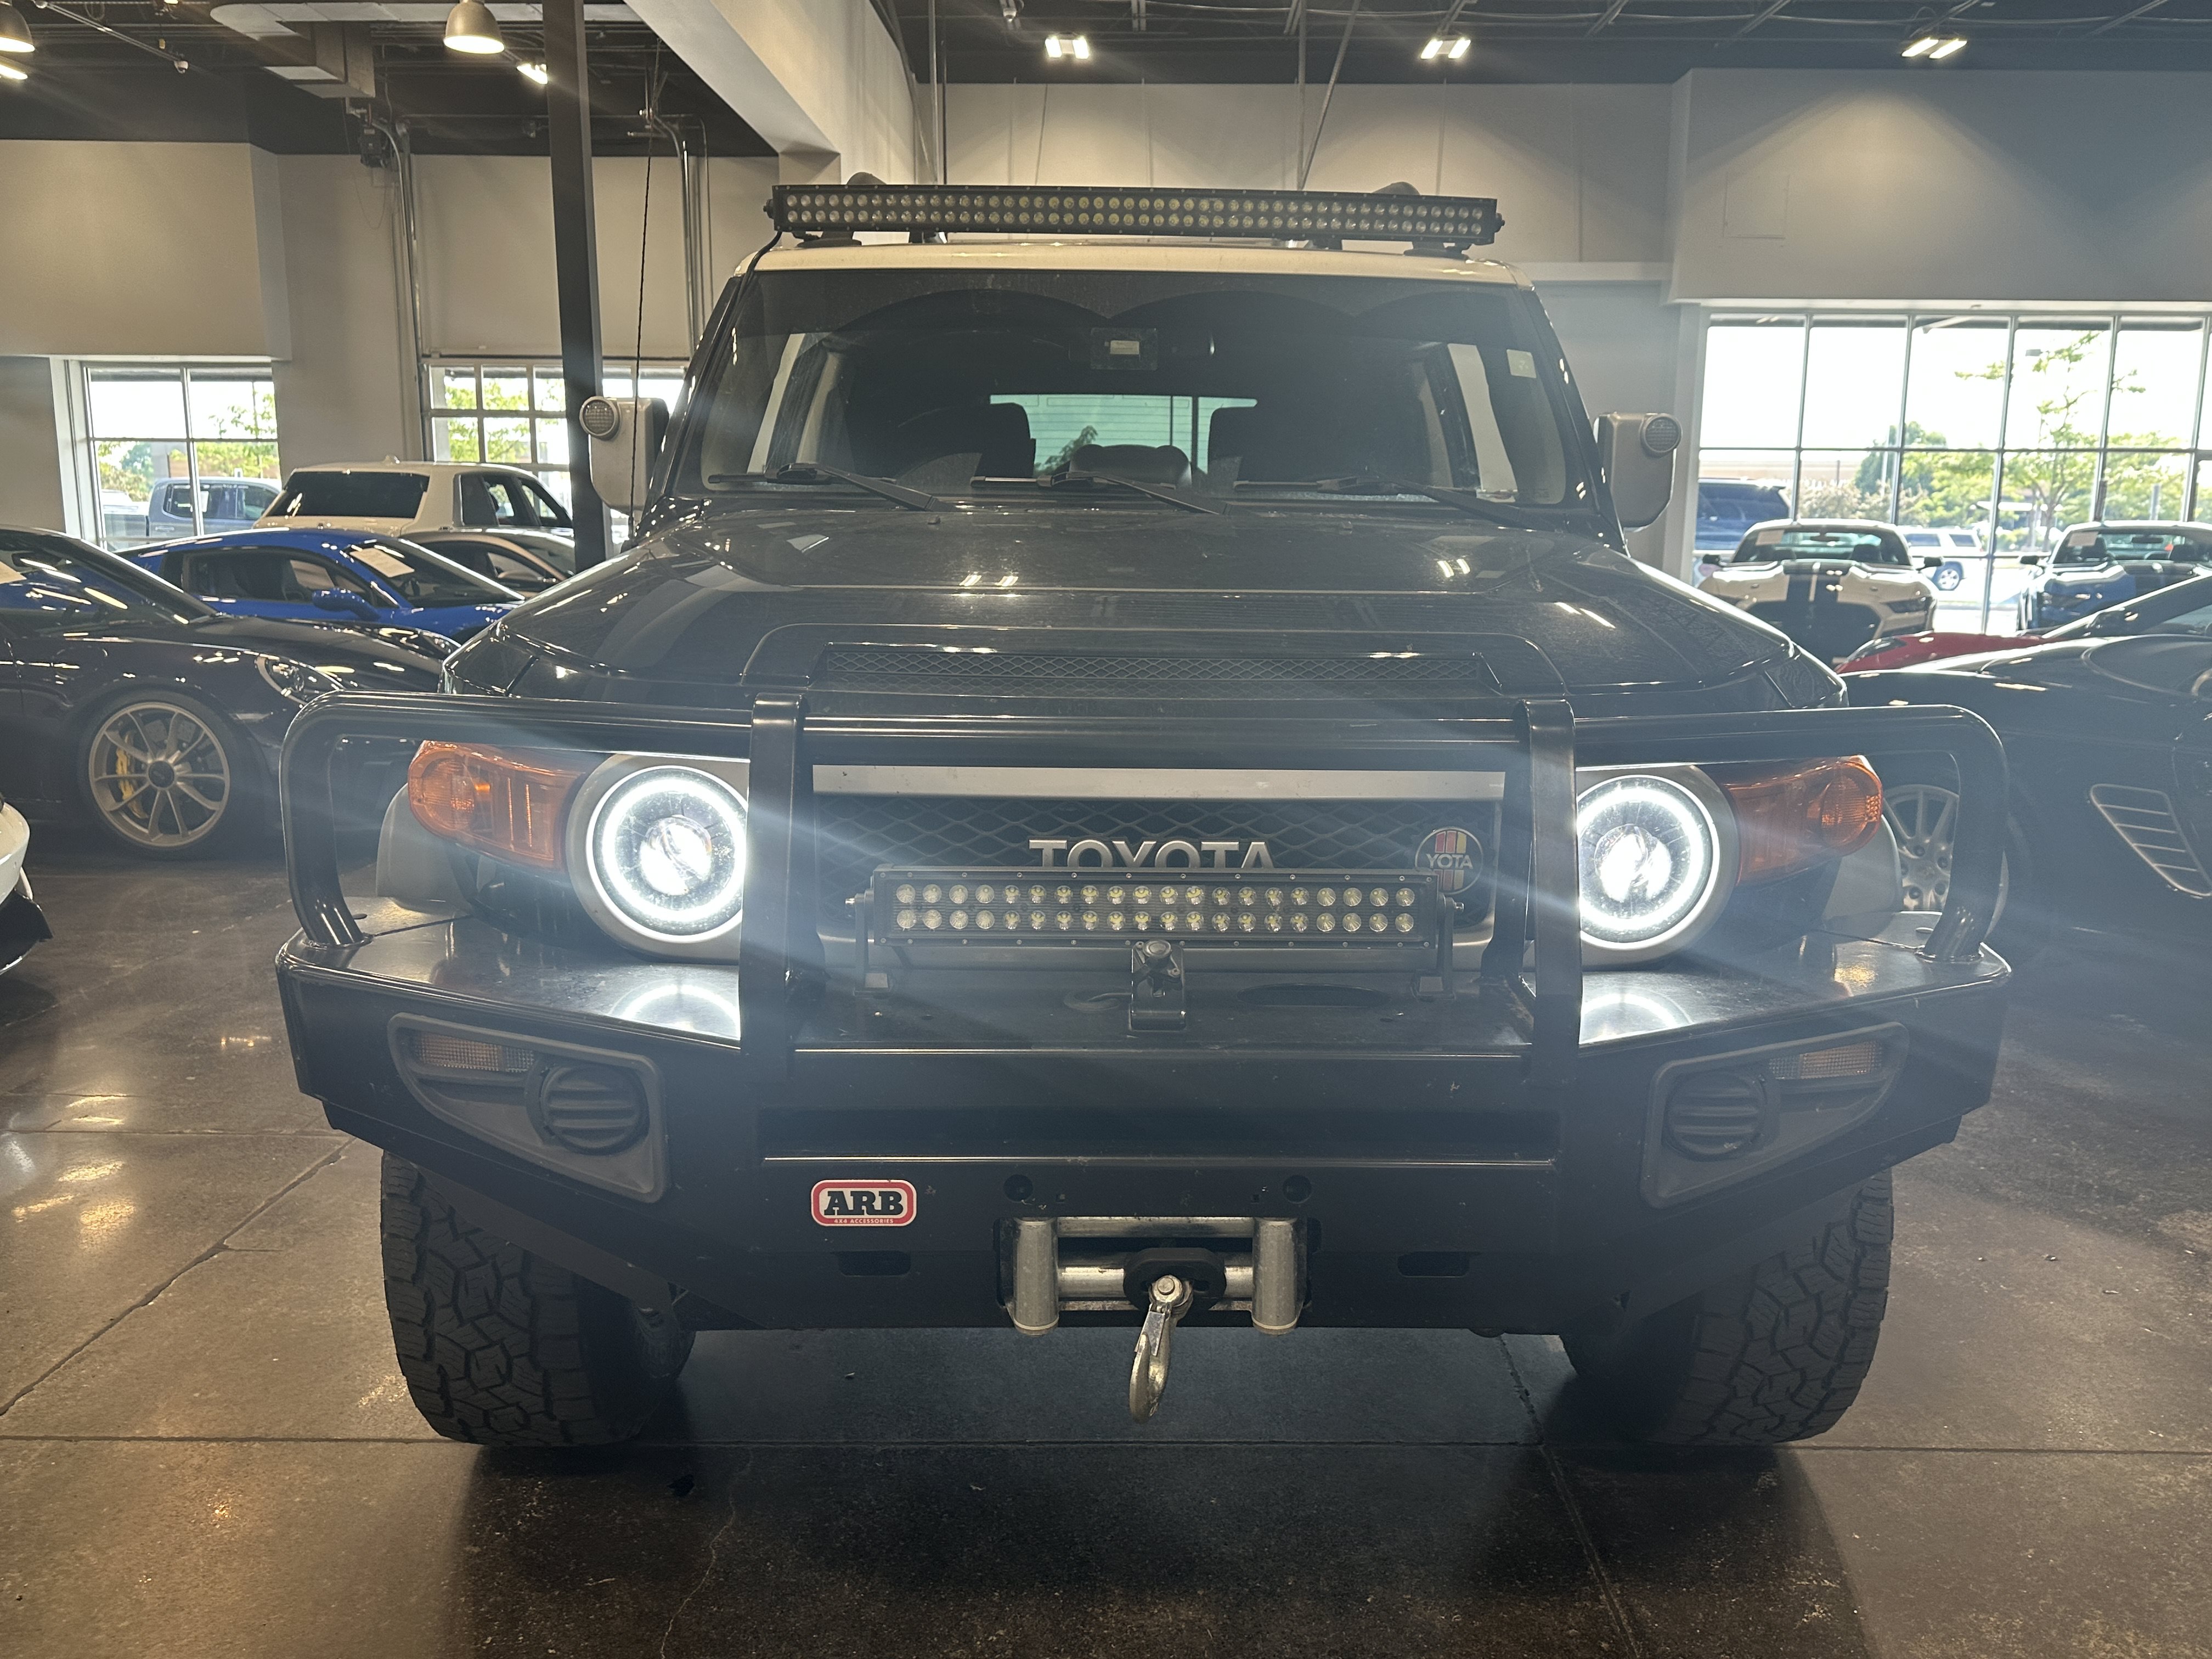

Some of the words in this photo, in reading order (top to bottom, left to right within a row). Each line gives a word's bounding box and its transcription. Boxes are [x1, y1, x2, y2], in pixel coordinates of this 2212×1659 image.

[1029, 839, 1274, 868] TOYOTA
[1426, 853, 1474, 870] YOTA
[824, 1190, 904, 1215] ARB
